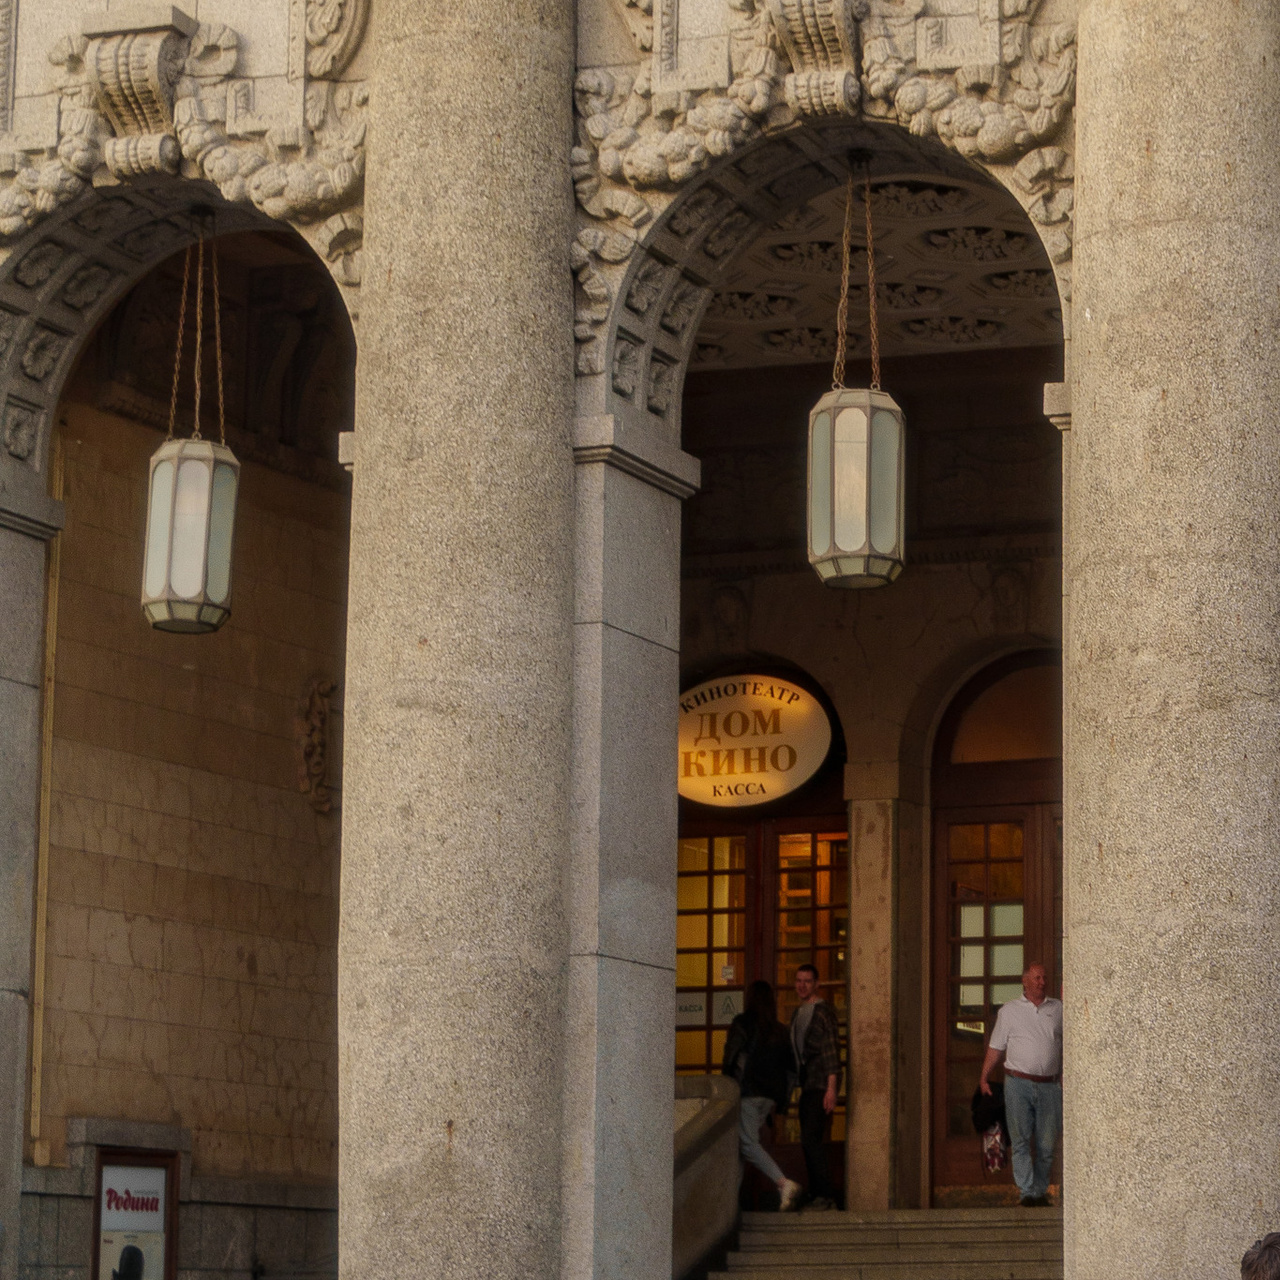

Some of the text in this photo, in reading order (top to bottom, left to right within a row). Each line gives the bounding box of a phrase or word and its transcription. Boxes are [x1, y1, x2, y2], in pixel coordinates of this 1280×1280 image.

[680, 682, 800, 714] КИНОТЕАТР
[694, 707, 783, 747] ДОМ
[681, 744, 798, 778] КИНО
[712, 782, 767, 797] КАССА
[105, 1187, 160, 1213] Родина
